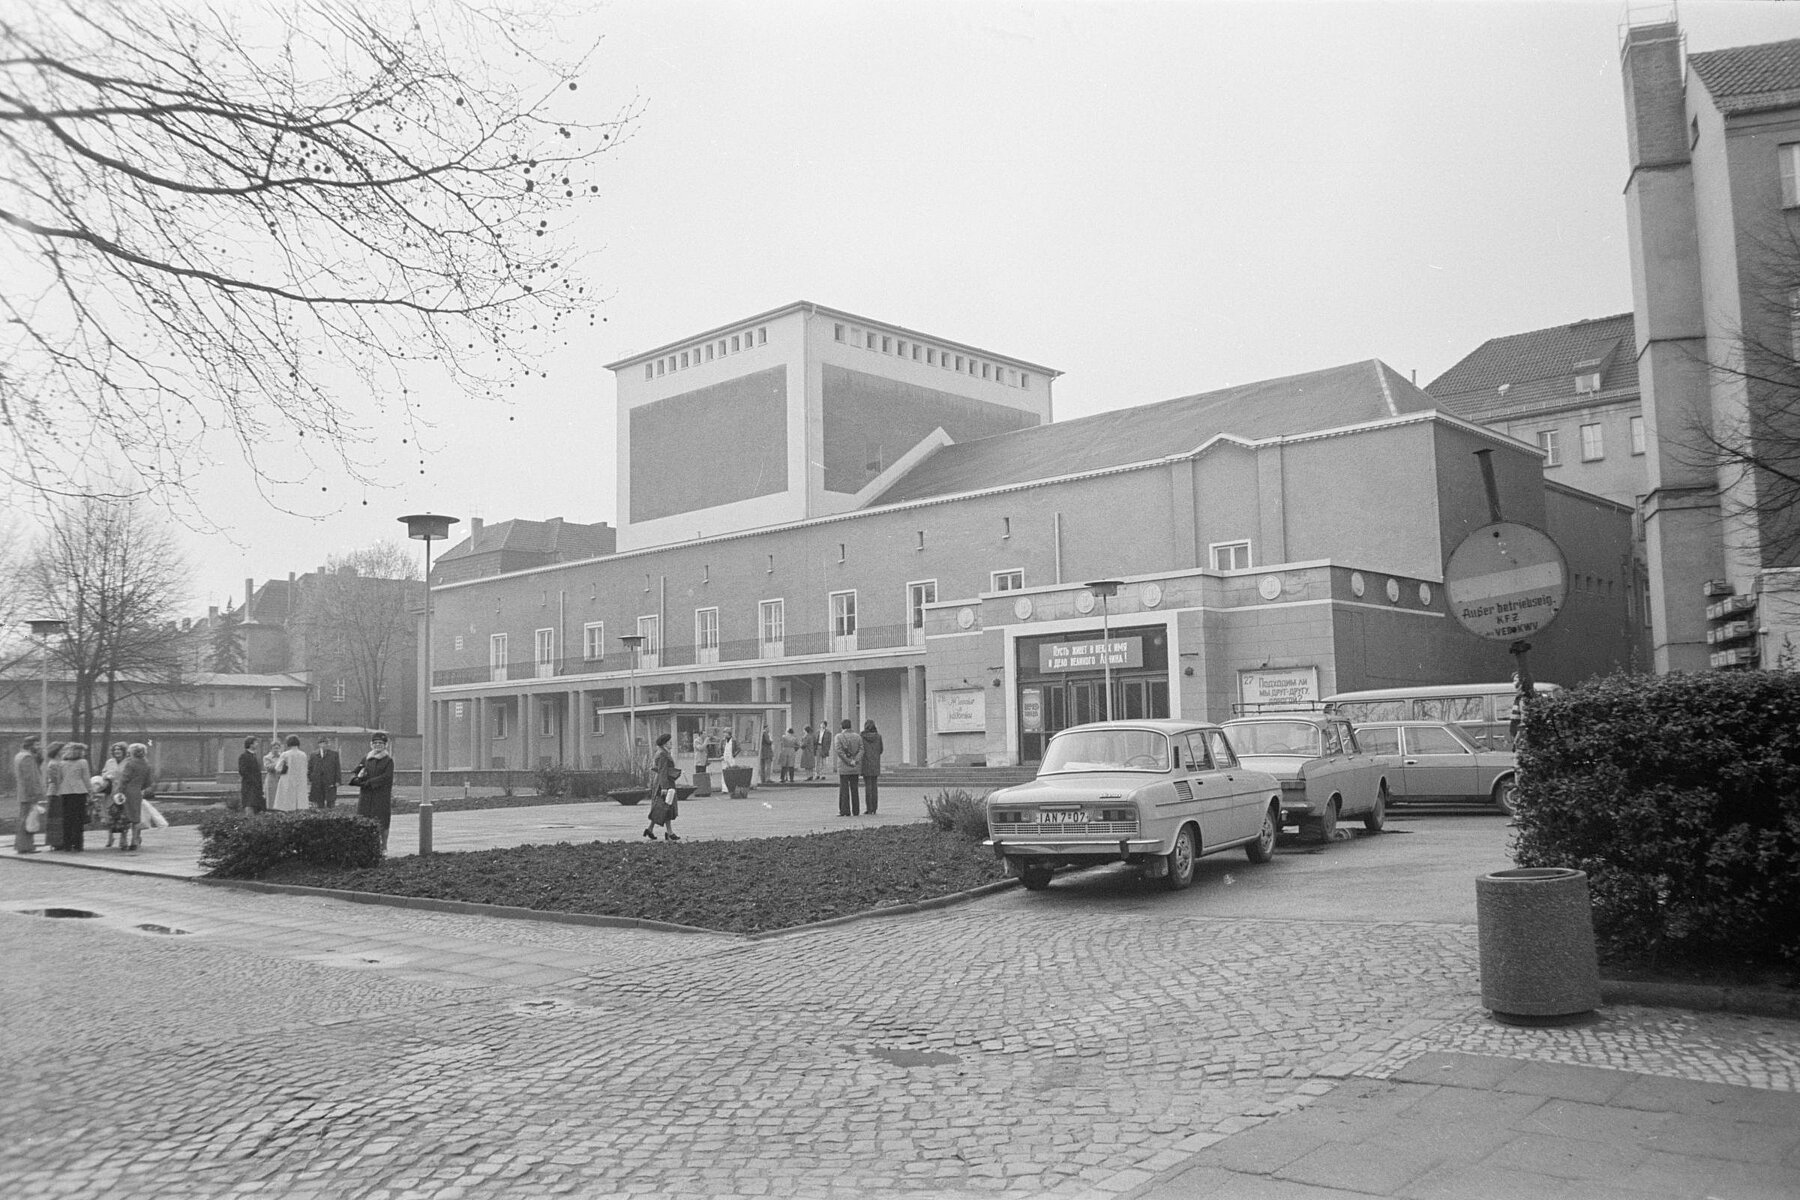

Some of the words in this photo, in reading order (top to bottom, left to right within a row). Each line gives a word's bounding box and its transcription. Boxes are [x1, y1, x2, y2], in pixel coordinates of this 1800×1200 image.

[1462, 606, 1495, 619] Außer
[1496, 613, 1520, 624] KFZ
[1243, 675, 1254, 686] 27
